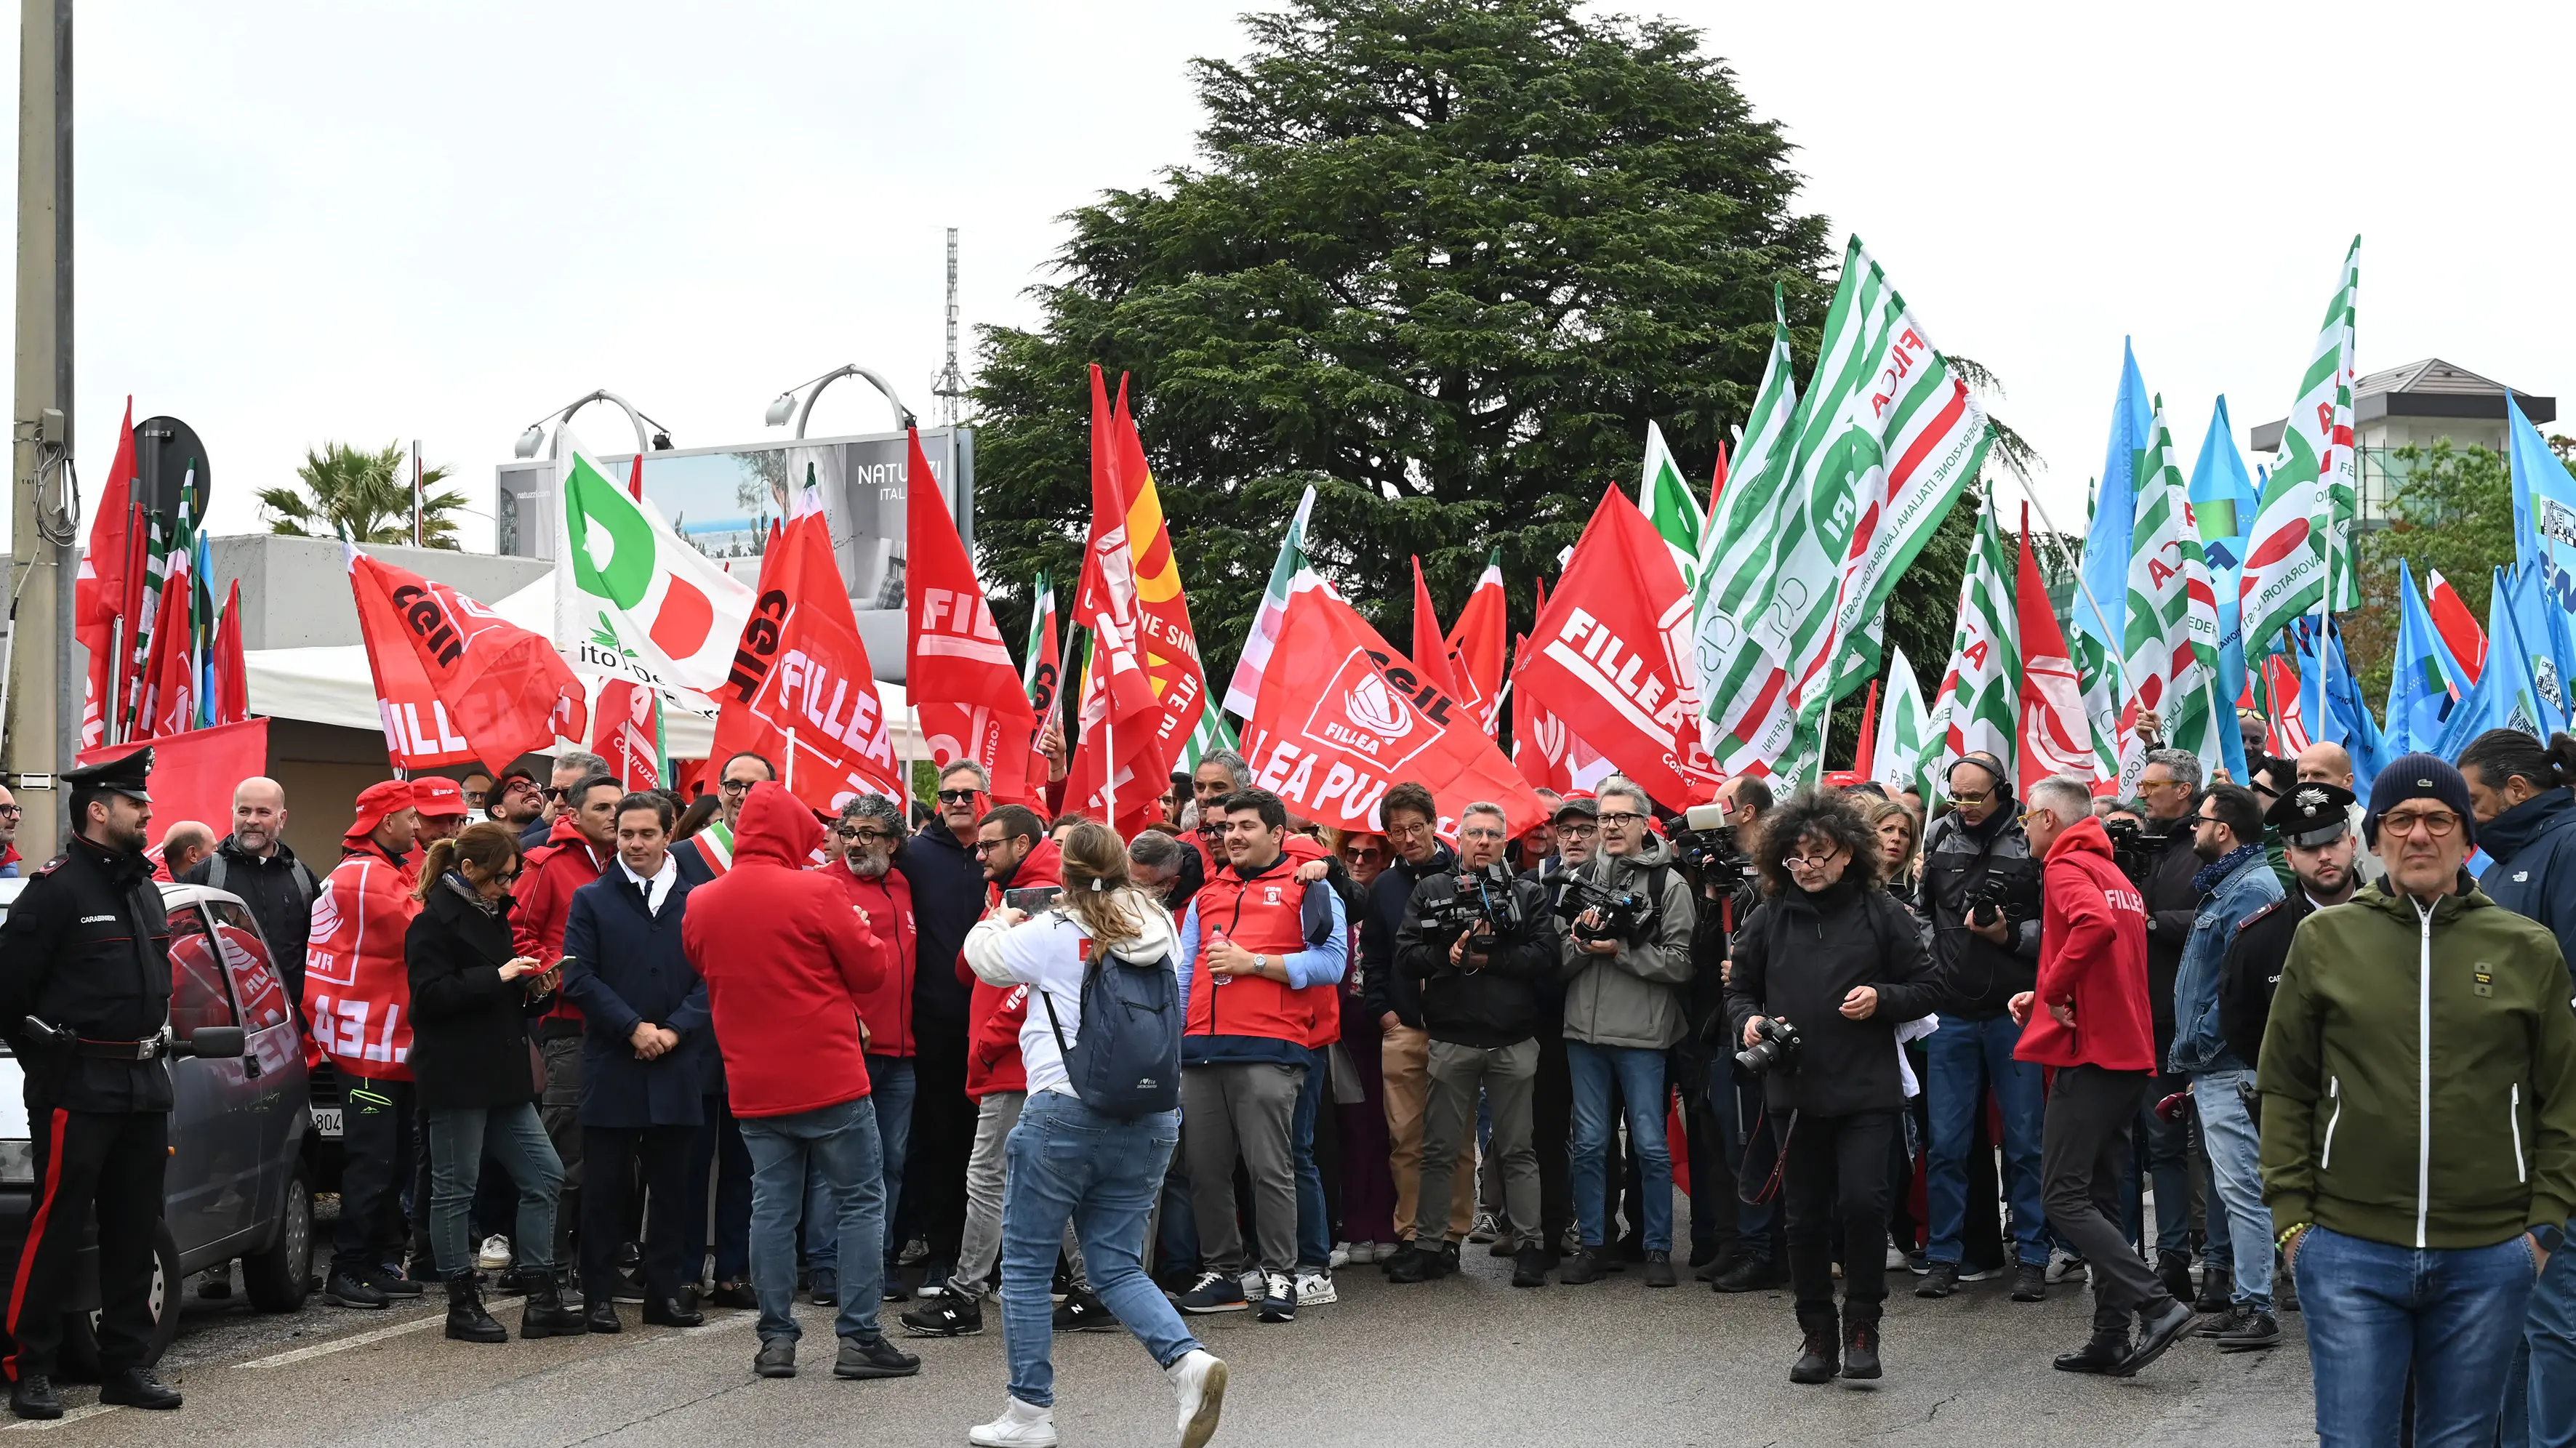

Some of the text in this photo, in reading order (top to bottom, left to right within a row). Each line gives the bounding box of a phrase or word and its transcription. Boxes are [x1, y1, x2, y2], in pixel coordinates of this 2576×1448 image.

[858, 459, 942, 485] NATUZI
[880, 487, 906, 501] ITAL
[921, 587, 1001, 641] FIL
[727, 589, 788, 705] CGIL
[1559, 606, 1685, 735] FILLEA
[612, 736, 659, 789] Cotruzio
[1324, 720, 1381, 757] FILLEA
